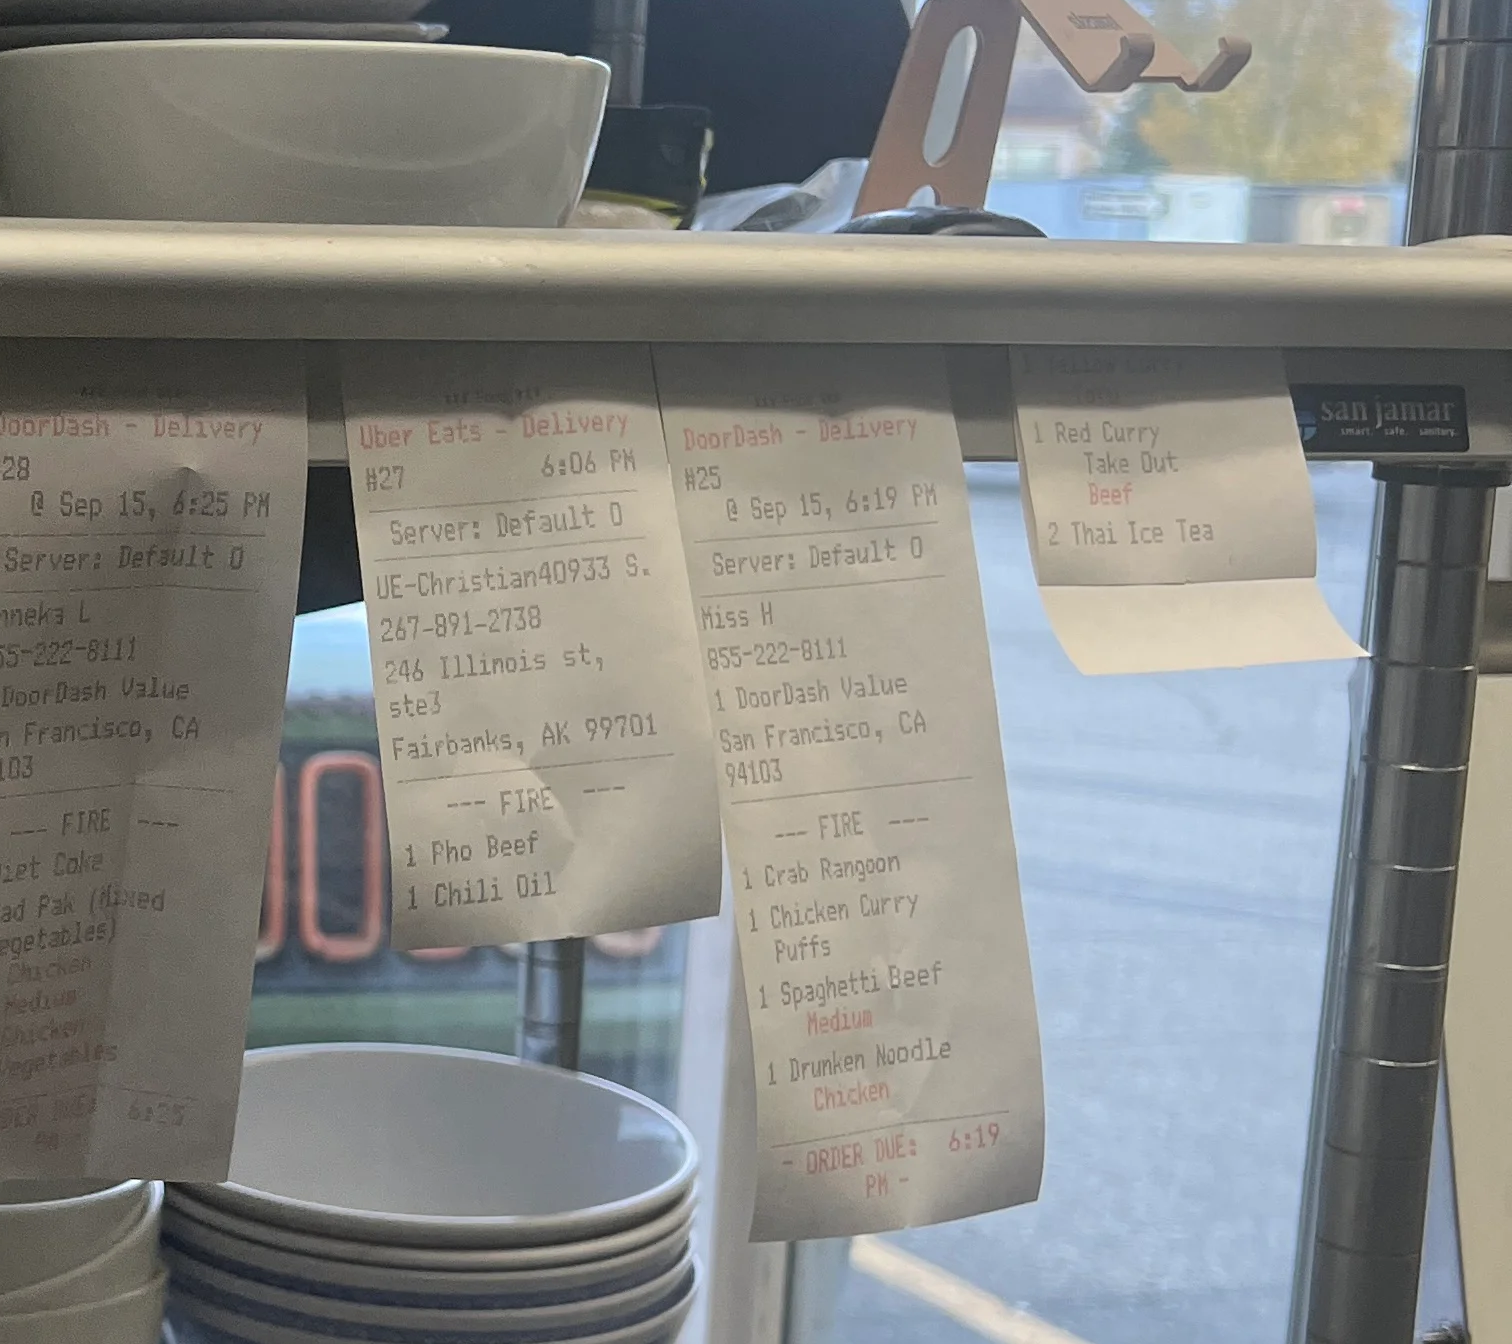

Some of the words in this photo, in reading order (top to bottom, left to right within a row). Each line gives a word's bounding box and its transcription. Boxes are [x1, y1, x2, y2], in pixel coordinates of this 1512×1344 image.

[154, 411, 262, 445] Delivery
[1321, 400, 1368, 422] san
[1374, 394, 1455, 429] jamar
[360, 424, 413, 449] Uber
[428, 418, 482, 445] Eats
[522, 412, 629, 438] Delivery
[684, 424, 782, 452] DoorDash
[819, 418, 918, 443] Delivery
[1055, 422, 1089, 444] Red
[1103, 423, 1159, 448] Curry
[541, 450, 597, 478] 6:06
[610, 448, 636, 471] PM
[1084, 452, 1129, 474] Take
[1141, 451, 1179, 473] Out
[60, 491, 103, 520] Sep
[244, 491, 270, 518] PM
[751, 497, 787, 524] Sep
[846, 487, 896, 514] 6:19
[913, 484, 937, 507] PM
[1089, 483, 1133, 506] Beef
[391, 517, 480, 545] Server:
[497, 505, 596, 538] Default
[1071, 521, 1116, 545] Thai
[1129, 521, 1163, 544] Ice
[1175, 518, 1214, 542] Tea
[5, 546, 101, 572] Server:
[713, 552, 796, 576] Server:
[810, 539, 896, 569] Default
[380, 606, 541, 642] 267-891-2738
[701, 605, 749, 630] Miss
[385, 658, 423, 685] 246
[440, 650, 546, 679] Illinois
[708, 637, 847, 670] 855-222-8111
[390, 692, 441, 718] ste3
[736, 681, 829, 709] DoorDash
[841, 674, 908, 698] Value
[172, 715, 199, 740] CA
[391, 728, 524, 760] Fairbanks,
[542, 721, 570, 745] AK
[585, 713, 658, 741] 99701
[720, 729, 755, 753] San
[765, 718, 882, 749] Francisco,
[899, 710, 927, 736] CA
[726, 758, 783, 787] 94103
[500, 786, 554, 815] FIRE
[62, 808, 111, 836] FIRE
[818, 812, 864, 839] FIRE
[432, 840, 472, 865] Pho
[487, 831, 538, 859] Beef
[765, 863, 809, 888] Crab
[821, 855, 900, 883] Rangoon
[435, 878, 502, 907] Chili
[516, 872, 557, 898] Oil
[771, 902, 849, 930] Chicken
[860, 894, 918, 918] Curry
[776, 936, 831, 963] Puffs
[781, 969, 880, 1010] Spaghetti
[889, 961, 942, 989] Beef
[808, 1009, 873, 1035] Medium
[790, 1050, 865, 1082] Drunken
[876, 1038, 951, 1068] Noodle
[814, 1081, 890, 1111] Chicken
[806, 1142, 863, 1175] ORDER
[876, 1134, 917, 1161] DUE:
[949, 1123, 1000, 1152] 6:19
[866, 1175, 887, 1198] PM
